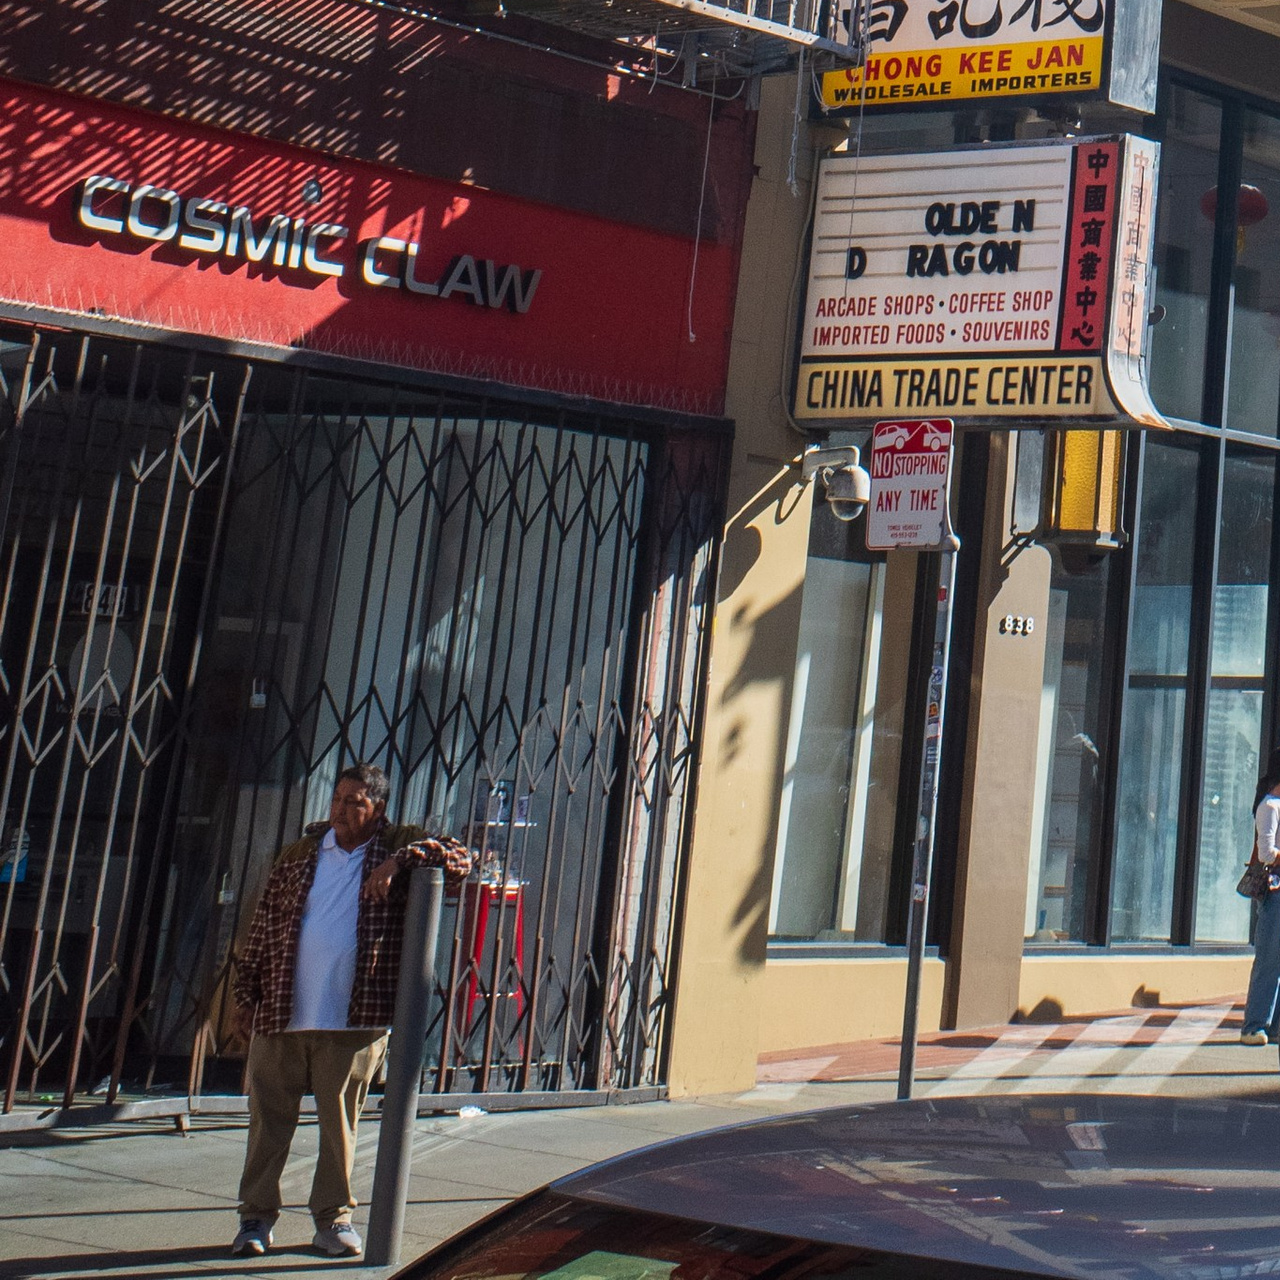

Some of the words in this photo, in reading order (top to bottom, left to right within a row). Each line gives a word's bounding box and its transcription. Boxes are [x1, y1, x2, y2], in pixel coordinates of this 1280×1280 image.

[958, 48, 1012, 75] KEE
[1026, 44, 1084, 68] JAN
[834, 80, 951, 102] WHOLESALE
[970, 70, 1092, 94] IMPORTERS
[78, 175, 349, 277] COSMIC
[363, 237, 542, 313] CLAW
[815, 295, 876, 318] ARCADE
[884, 292, 935, 315] SHOPS
[948, 291, 1006, 314] COFFEE
[1012, 289, 1053, 311] SHOP
[813, 324, 890, 346] IMPORTED
[896, 322, 945, 345] FOODS
[962, 320, 1050, 343] SOUVENIRS
[807, 368, 883, 410] CHINA
[893, 366, 979, 408] TRADE
[986, 364, 1093, 407] CENTER
[874, 453, 892, 477] NO
[894, 454, 946, 476] STOPPING
[876, 490, 902, 512] ANY
[910, 489, 938, 511] TIME
[1003, 614, 1035, 634] 838
